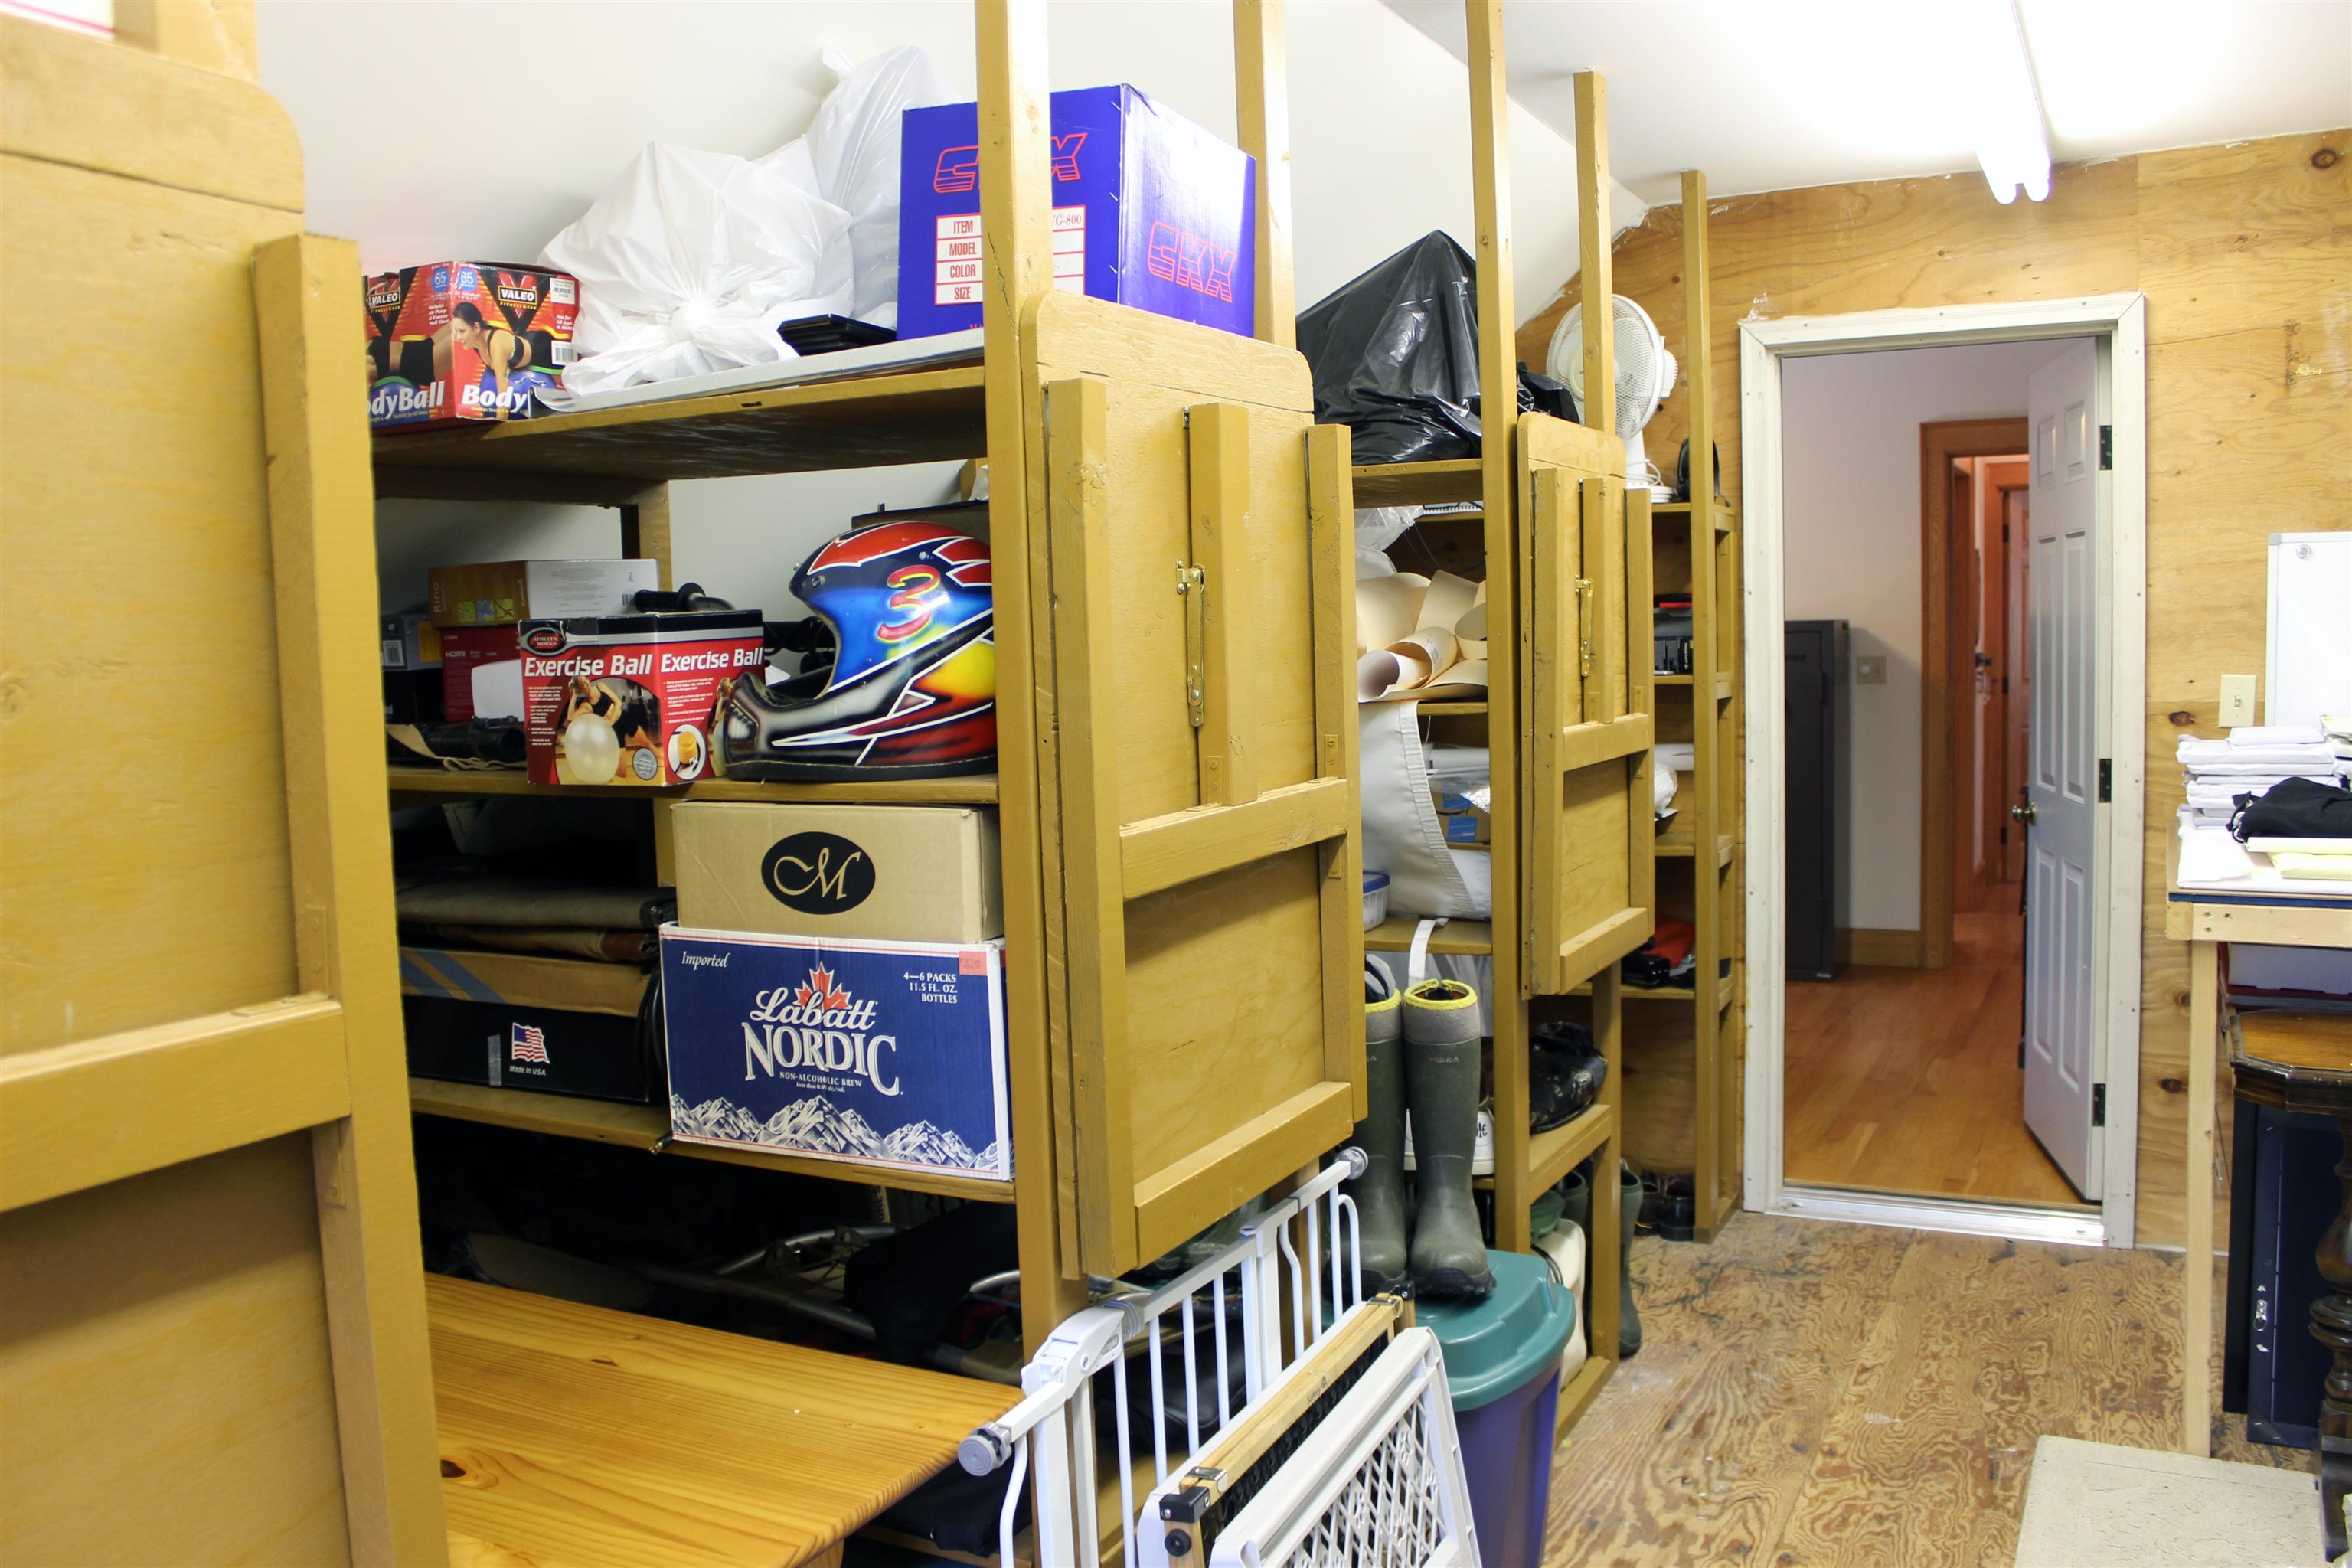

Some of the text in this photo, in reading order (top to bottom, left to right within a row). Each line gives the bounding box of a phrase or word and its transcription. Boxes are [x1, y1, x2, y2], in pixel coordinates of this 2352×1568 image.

[953, 220, 974, 234] ITEM
[949, 241, 977, 256] MODEL
[1147, 221, 1236, 304] CKX
[434, 271, 446, 285] 65
[460, 271, 474, 285] 65
[949, 264, 976, 279] COLOR
[371, 292, 398, 305] VALEO
[501, 289, 535, 302] VALEO
[954, 286, 972, 300] SIZE
[368, 381, 445, 420] dyBall
[462, 384, 528, 413] Body
[524, 654, 653, 678] Exercise Ball
[660, 647, 763, 673] Exercise Ball
[681, 951, 731, 971] Imported
[926, 972, 957, 983] PACKS
[910, 982, 958, 994] 11.5 FL. OZ.
[921, 993, 958, 1004] BOTTLES
[750, 987, 877, 1031] Labatt
[741, 1022, 900, 1096] NORDIC
[509, 1065, 525, 1073] Made
[779, 1072, 863, 1087] NON-ALCOHOLIC BREW
